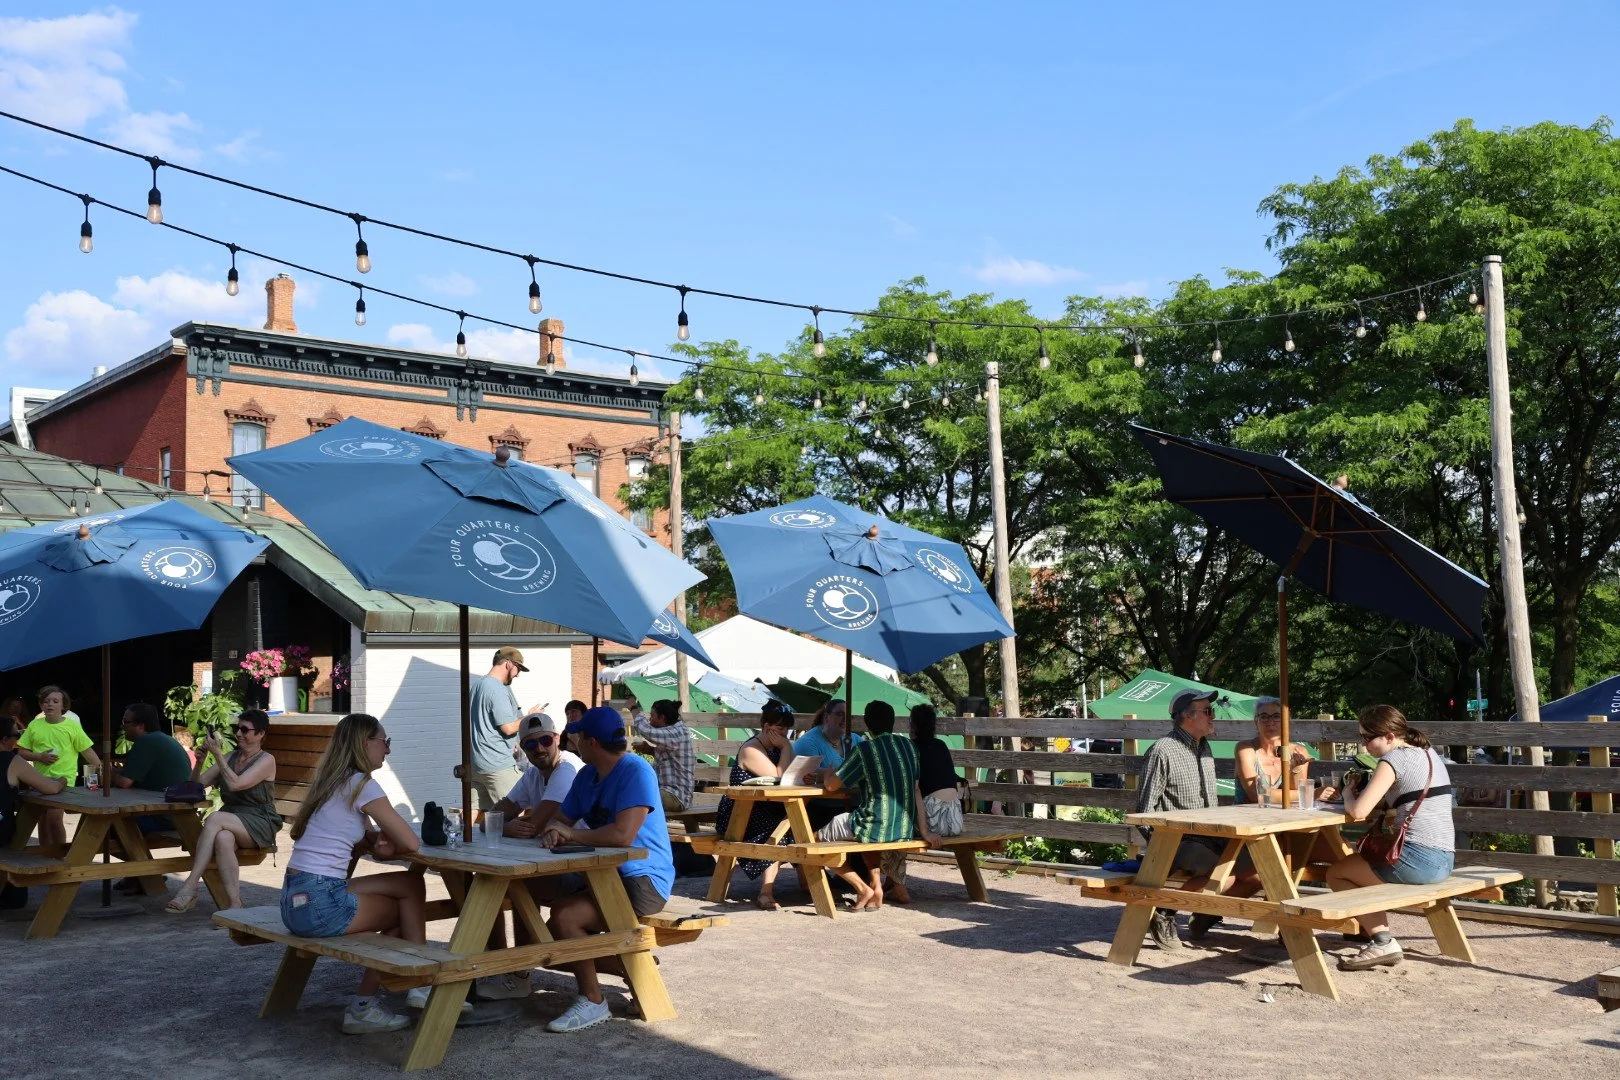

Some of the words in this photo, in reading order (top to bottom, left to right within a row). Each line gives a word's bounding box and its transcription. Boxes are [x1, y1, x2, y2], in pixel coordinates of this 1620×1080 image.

[455, 520, 521, 537] QUARTERS
[450, 539, 465, 568] FOUR
[160, 579, 187, 589] FOUR
[522, 569, 551, 591] BREWING
[806, 588, 817, 608] FOUR
[815, 575, 864, 587] QUARTERS
